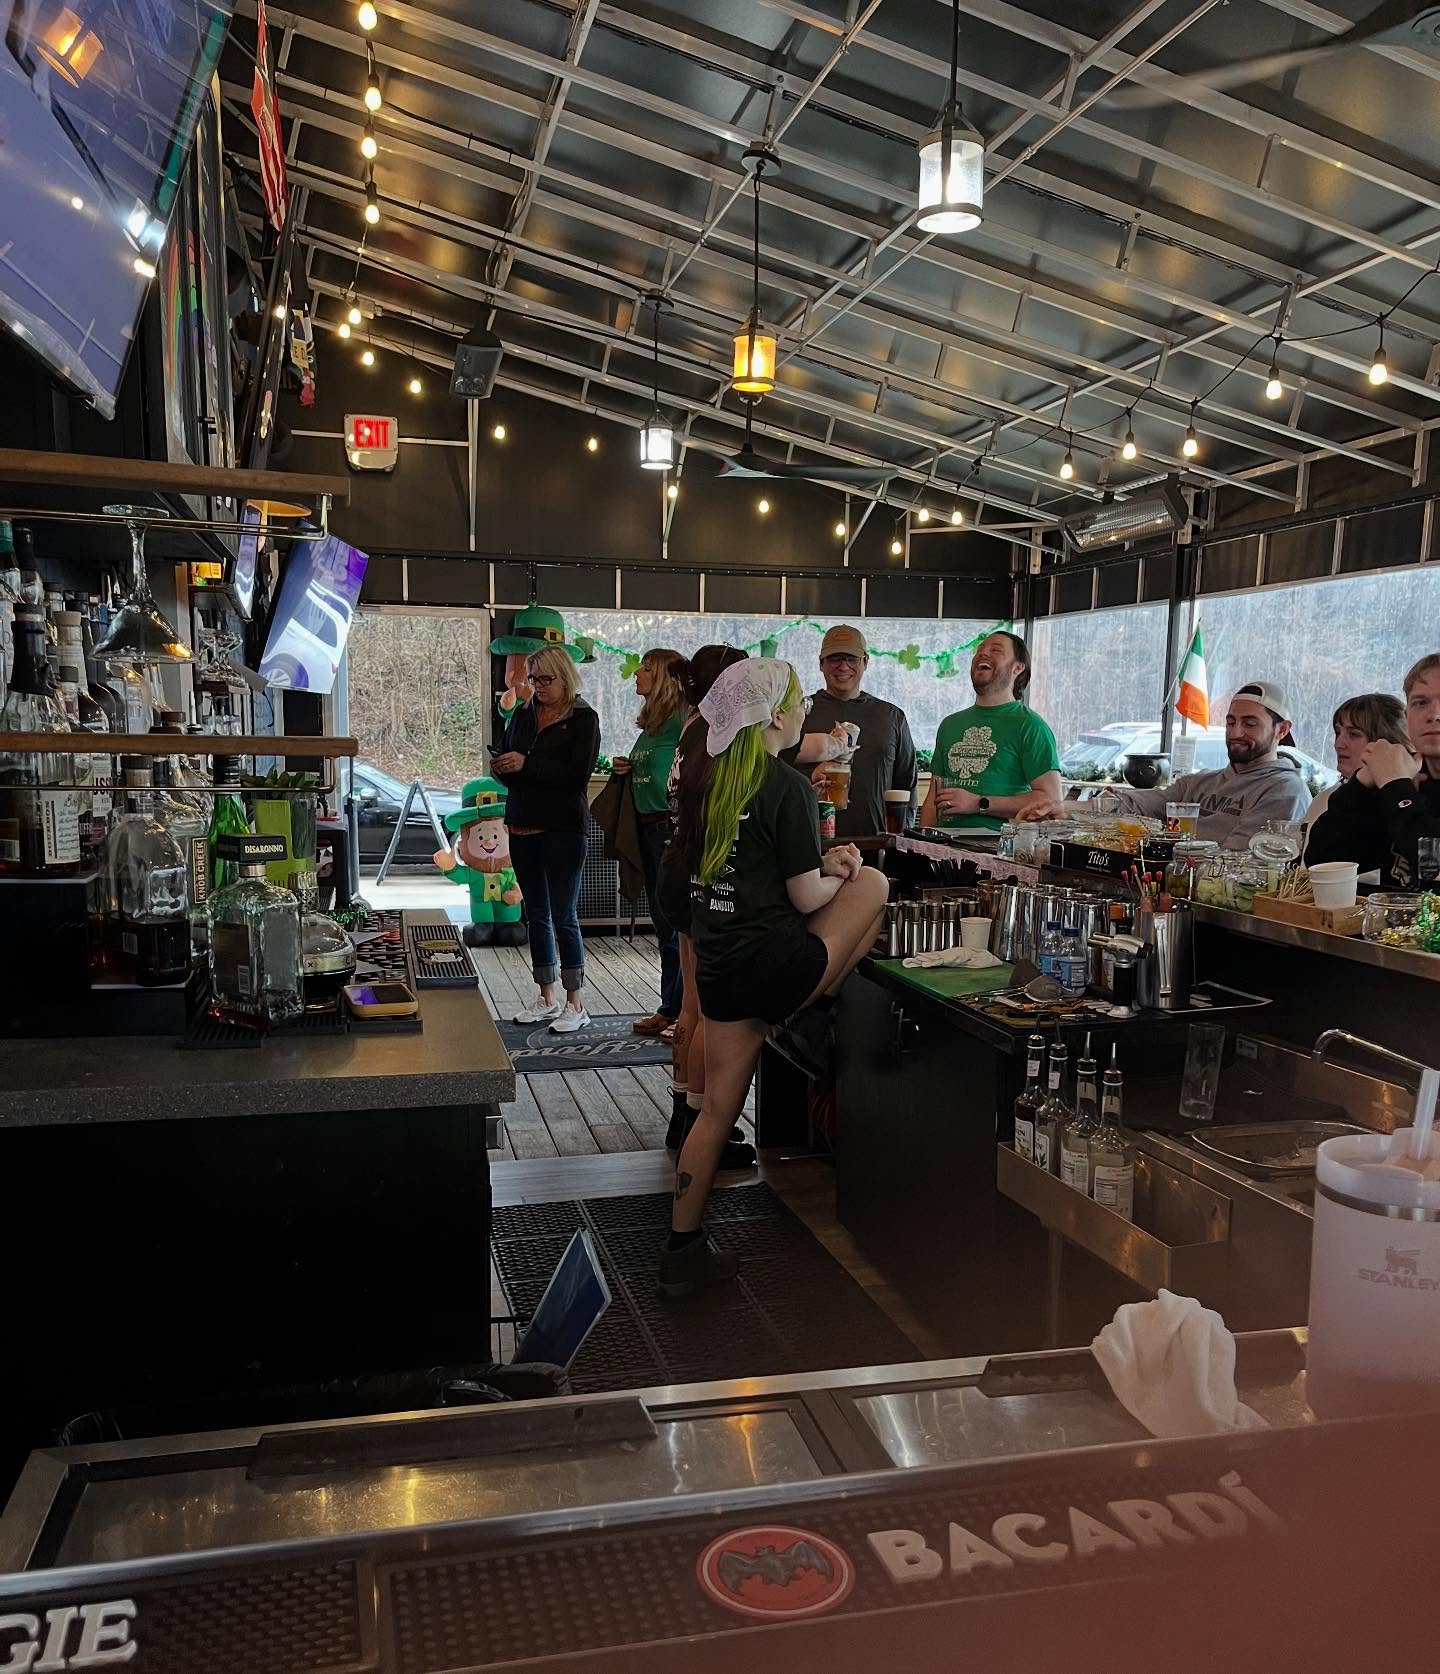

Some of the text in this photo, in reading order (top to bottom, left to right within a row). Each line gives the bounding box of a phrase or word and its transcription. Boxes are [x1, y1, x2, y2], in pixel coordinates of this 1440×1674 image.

[354, 419, 390, 449] EXIT
[244, 844, 284, 854] DISARONNO
[1087, 850, 1110, 866] Tito's
[196, 841, 206, 900] KNOB CREEK
